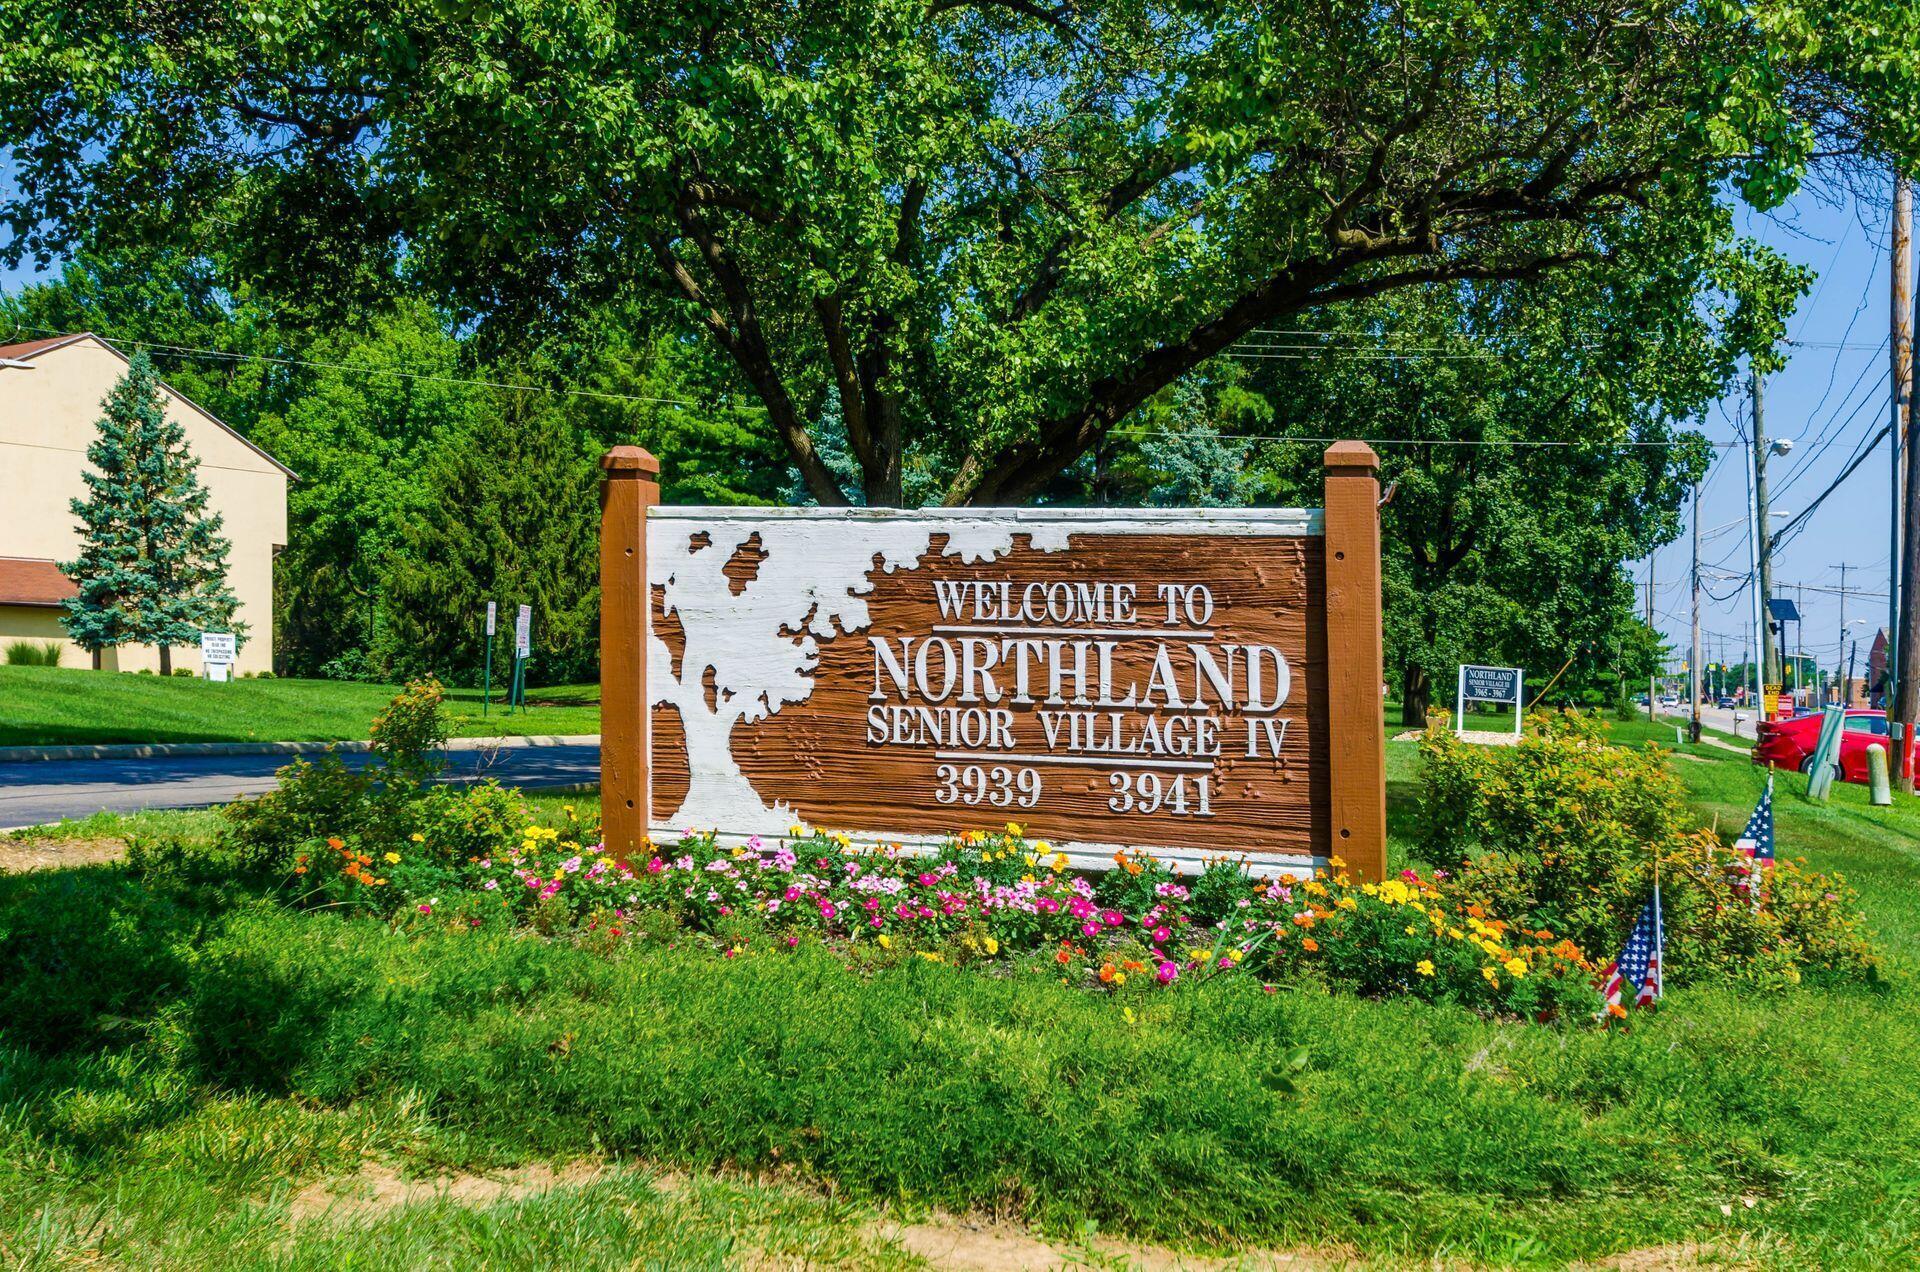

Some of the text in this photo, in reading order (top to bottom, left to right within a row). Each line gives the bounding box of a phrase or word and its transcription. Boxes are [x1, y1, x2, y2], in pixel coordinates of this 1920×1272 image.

[933, 580, 1214, 627] WELCOME TO
[867, 635, 1291, 713] NORTHLAND
[1469, 670, 1512, 681] NORTHLAND
[1474, 688, 1488, 697] 3965
[1492, 690, 1506, 698] 3967
[866, 704, 1291, 758] SENIOR VILLAGE IV
[934, 763, 1216, 817] 3939 3941
